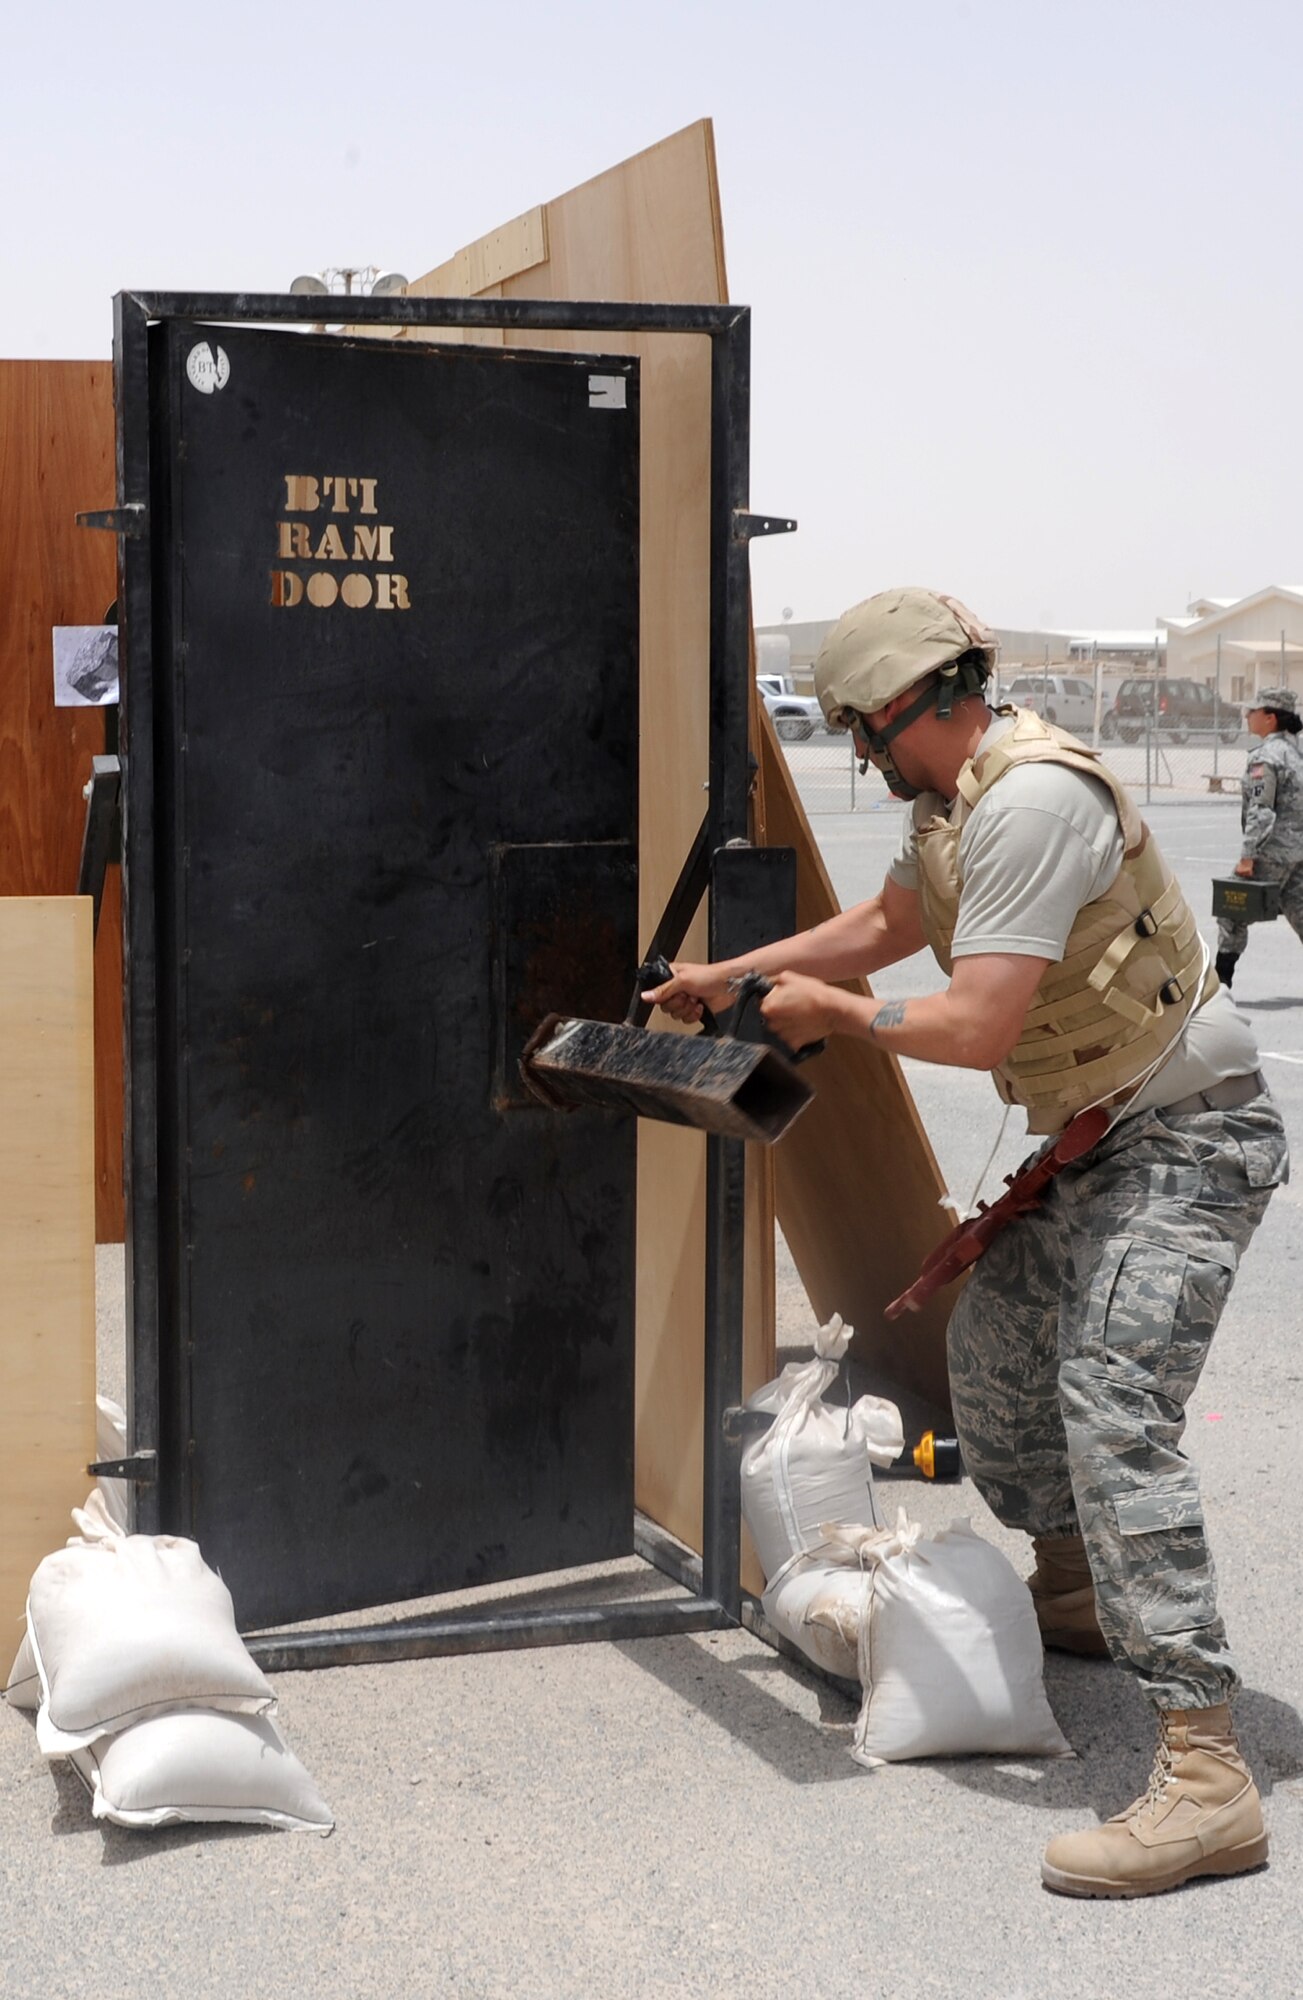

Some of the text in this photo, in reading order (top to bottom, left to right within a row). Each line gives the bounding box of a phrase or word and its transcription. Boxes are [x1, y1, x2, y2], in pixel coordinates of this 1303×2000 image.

[285, 475, 378, 514] BTI
[277, 522, 394, 562] RAM
[269, 571, 411, 610] DOOR
